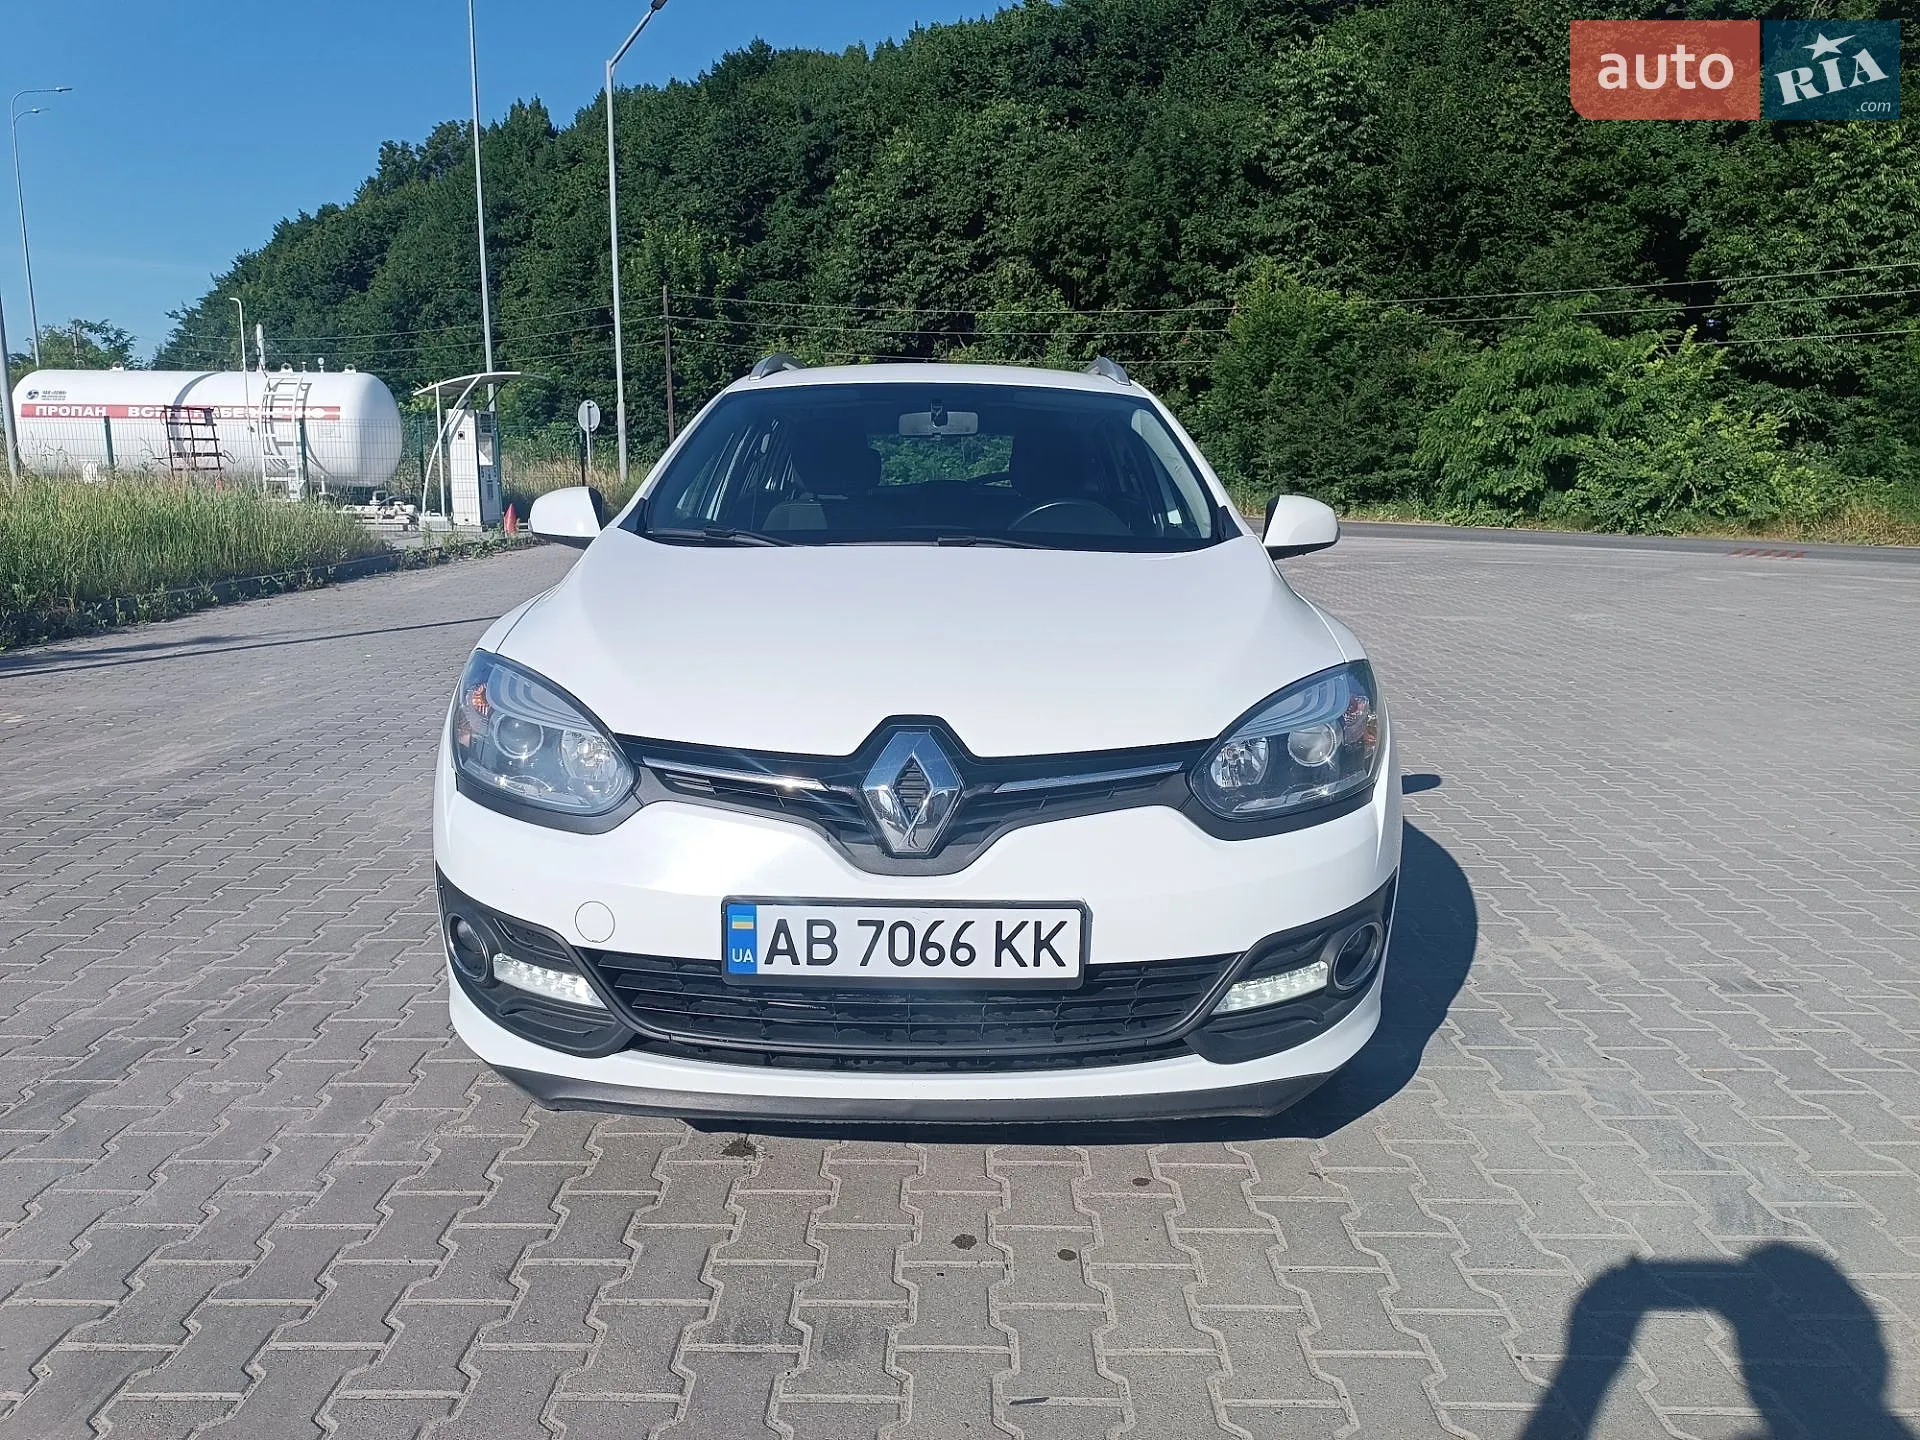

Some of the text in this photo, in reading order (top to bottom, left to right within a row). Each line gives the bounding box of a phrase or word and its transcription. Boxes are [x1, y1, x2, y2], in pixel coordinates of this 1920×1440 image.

[35, 405, 107, 417] ПРОПАН
[763, 918, 1068, 968] AB 7066 KK
[732, 948, 755, 964] UA
